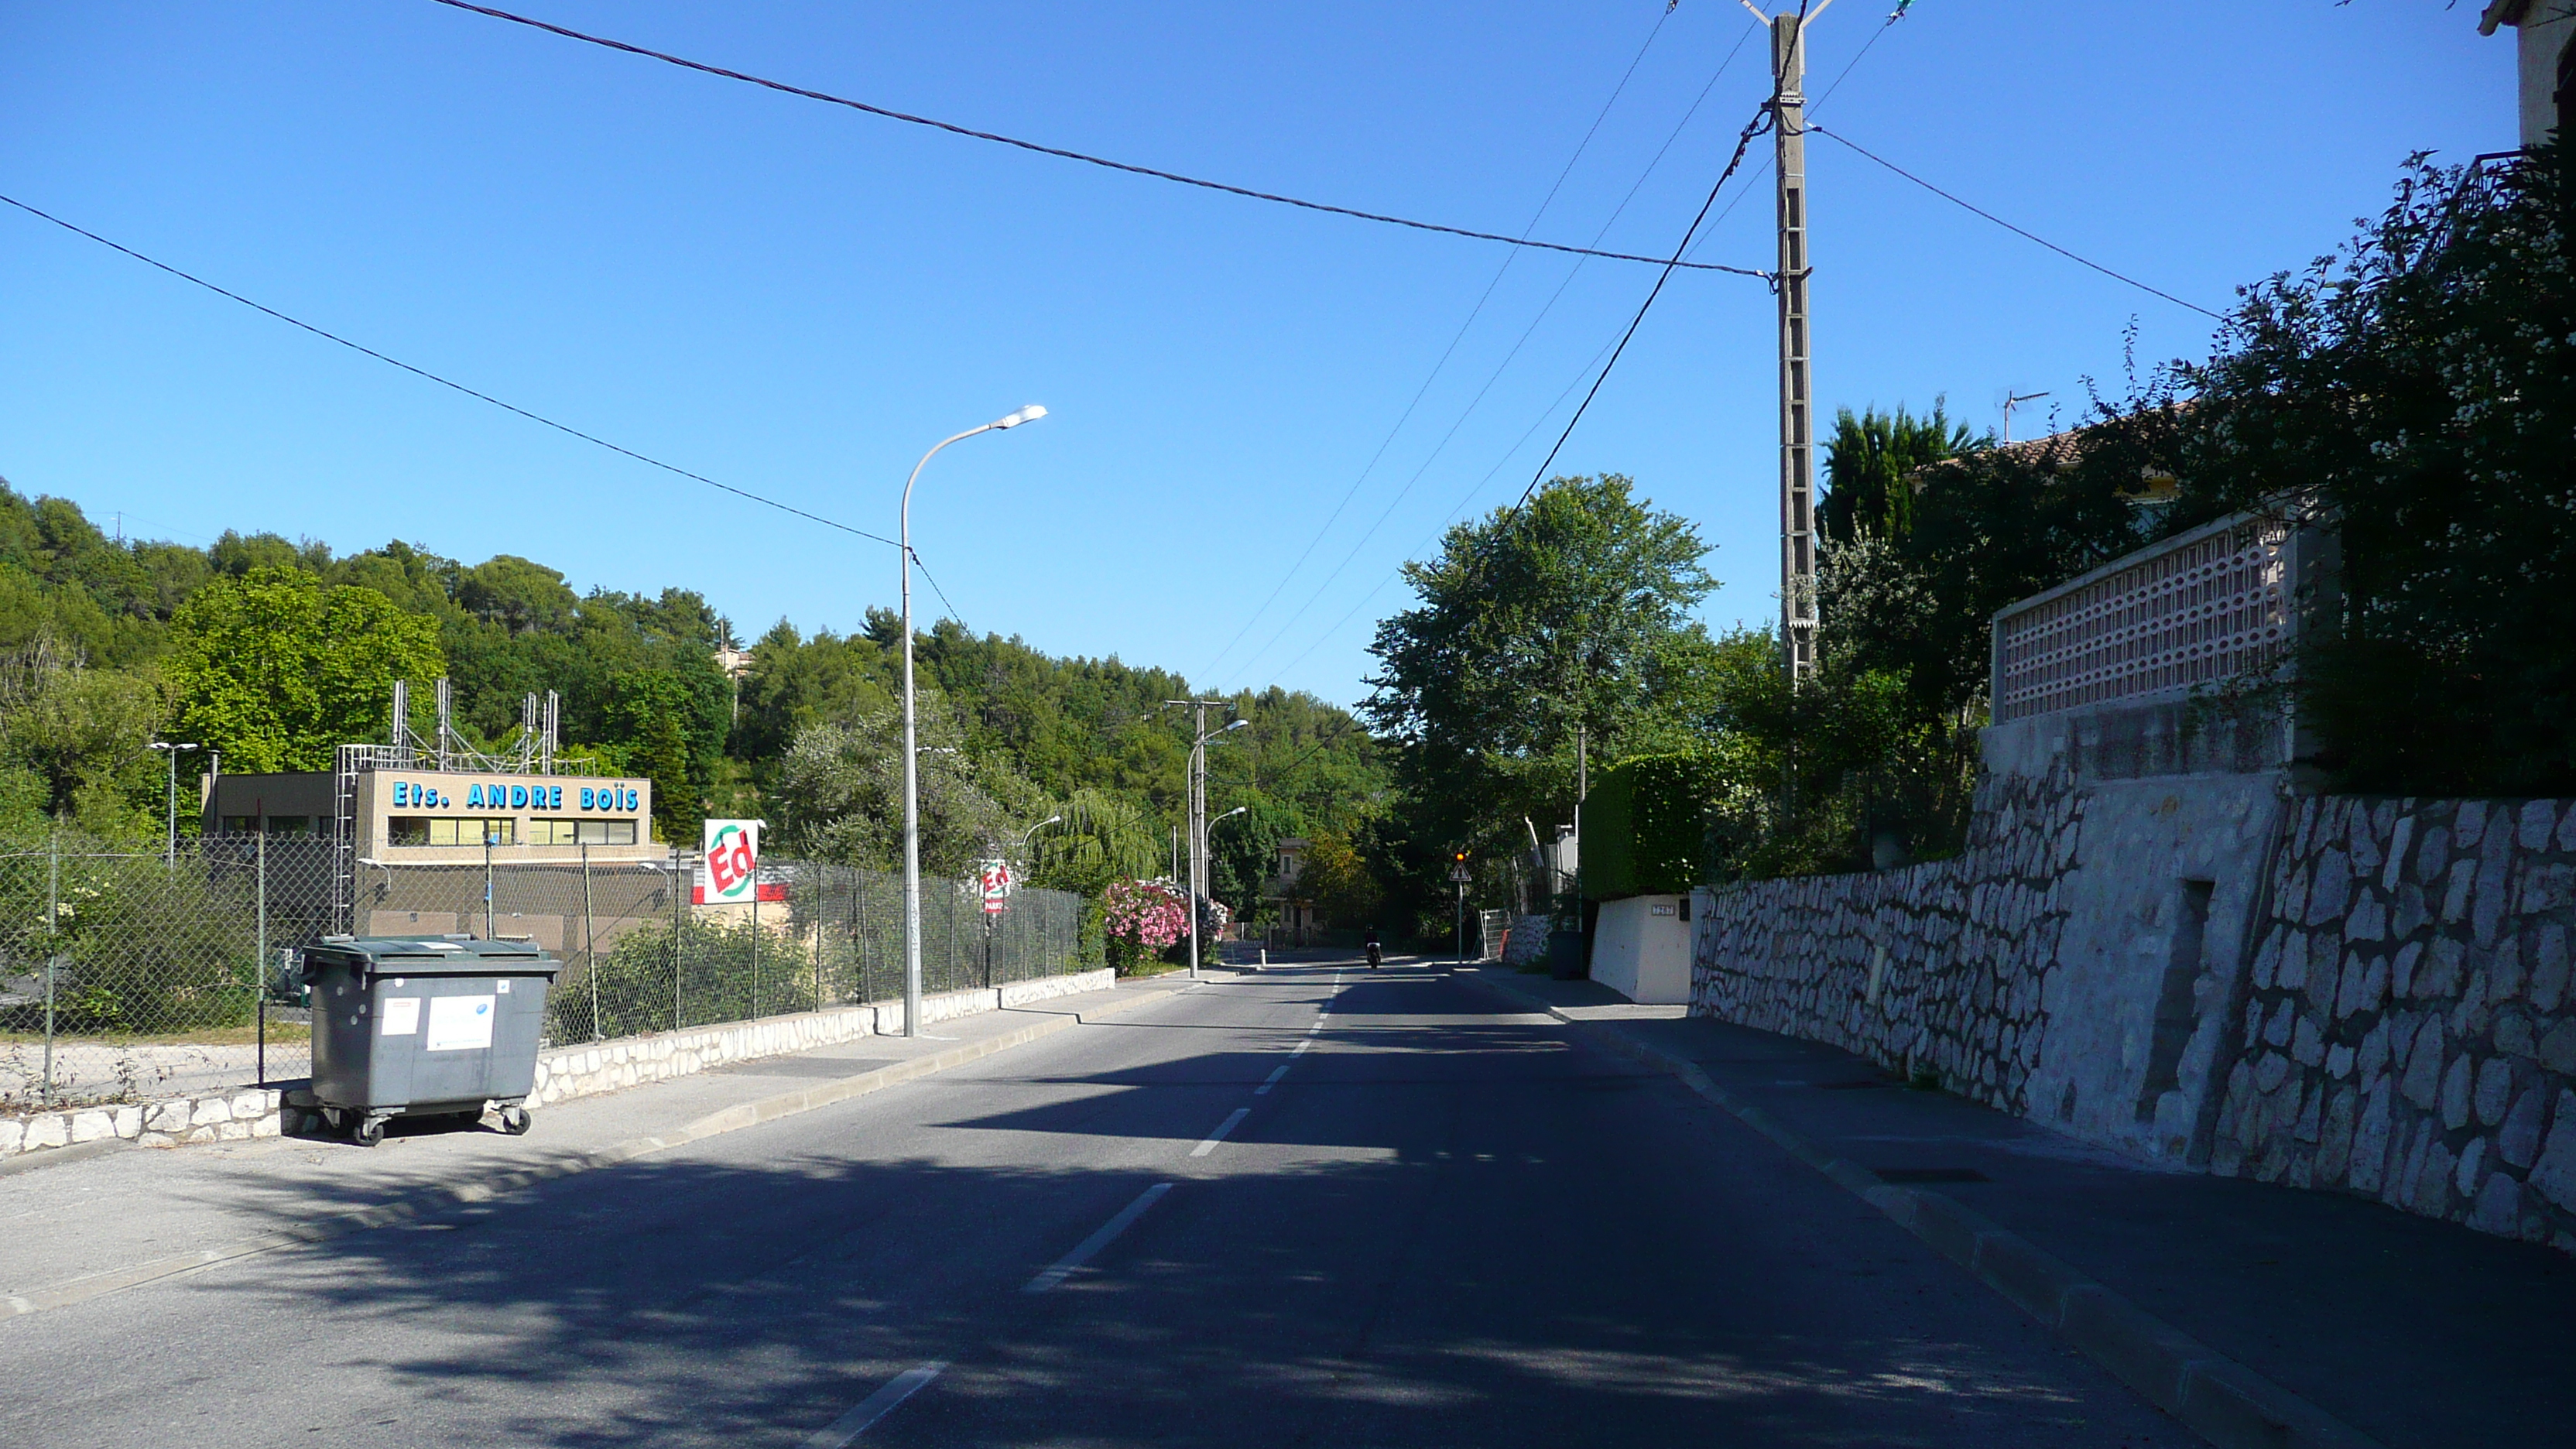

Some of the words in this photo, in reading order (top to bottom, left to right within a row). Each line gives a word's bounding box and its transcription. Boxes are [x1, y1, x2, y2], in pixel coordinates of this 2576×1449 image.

[393, 782, 449, 808] Ets.
[466, 783, 562, 810] ANDRE
[707, 829, 756, 893] Ed
[981, 865, 1009, 892] Ed
